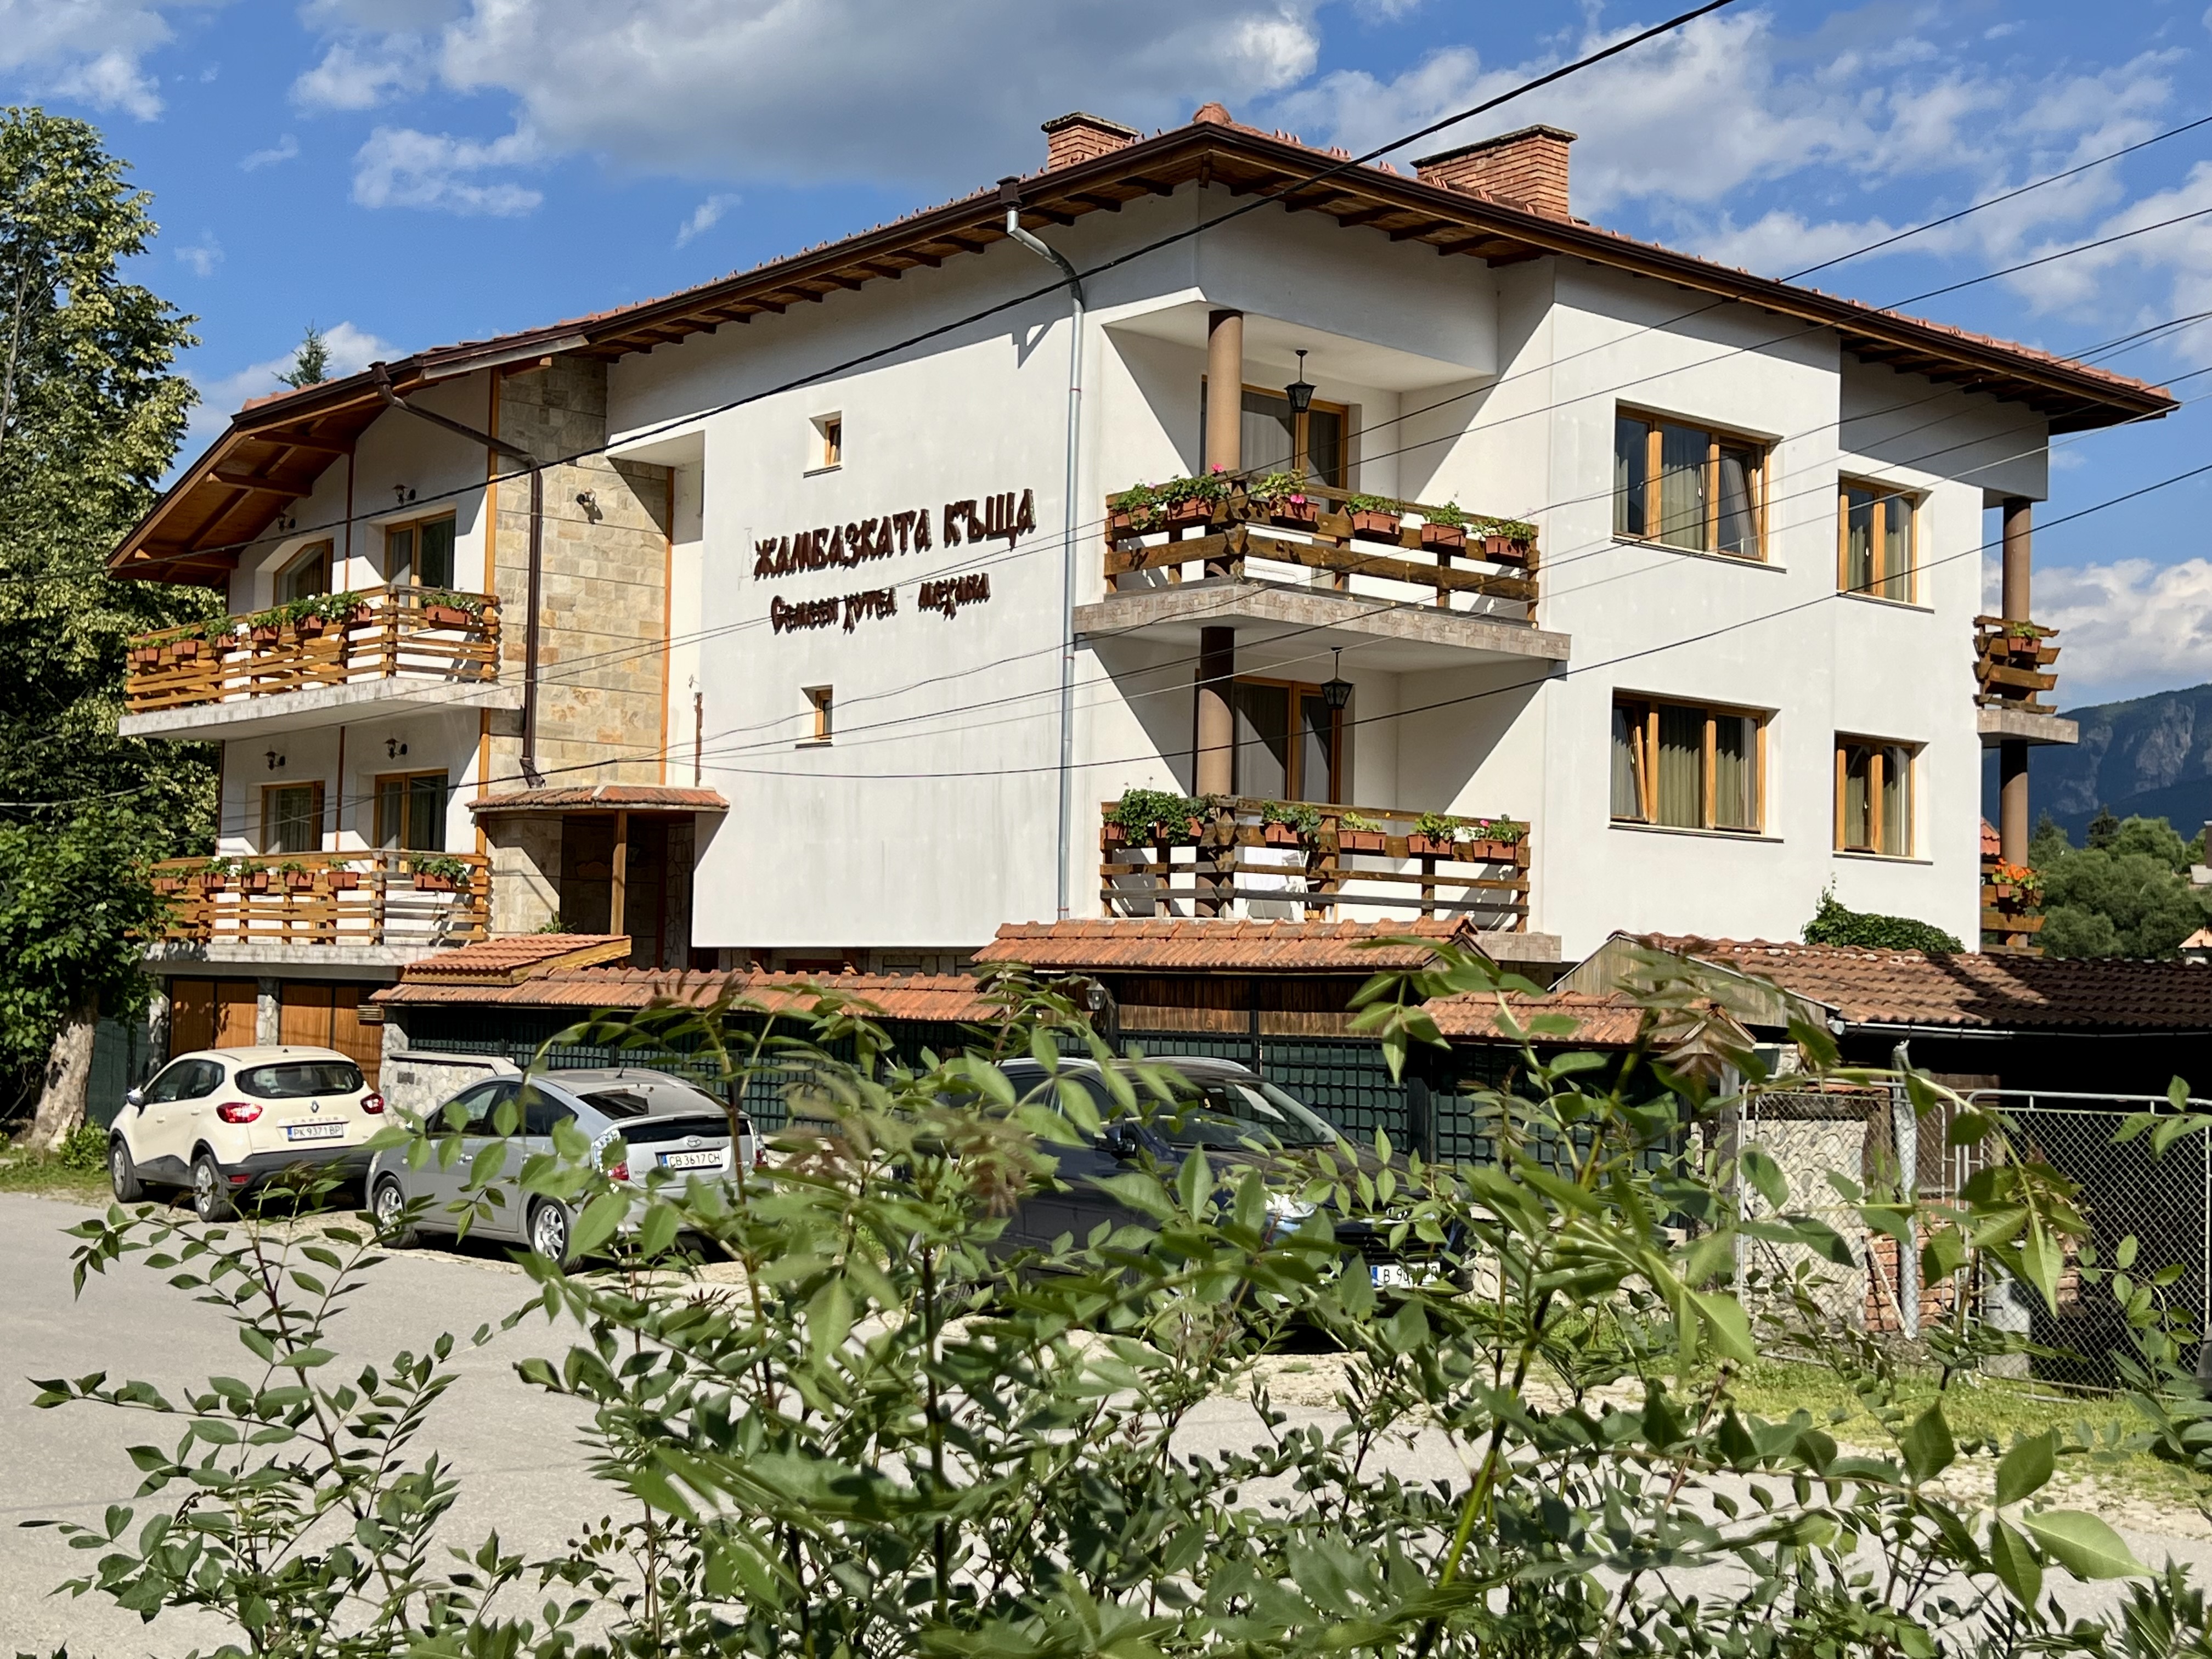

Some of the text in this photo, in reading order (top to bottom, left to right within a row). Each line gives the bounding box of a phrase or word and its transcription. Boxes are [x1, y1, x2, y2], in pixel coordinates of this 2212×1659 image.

[754, 489, 1036, 579] ЖАМБАЗКАТА КЪЩА
[843, 588, 898, 634] хотел
[918, 573, 990, 620] механа
[684, 1154, 706, 1165] 3617
